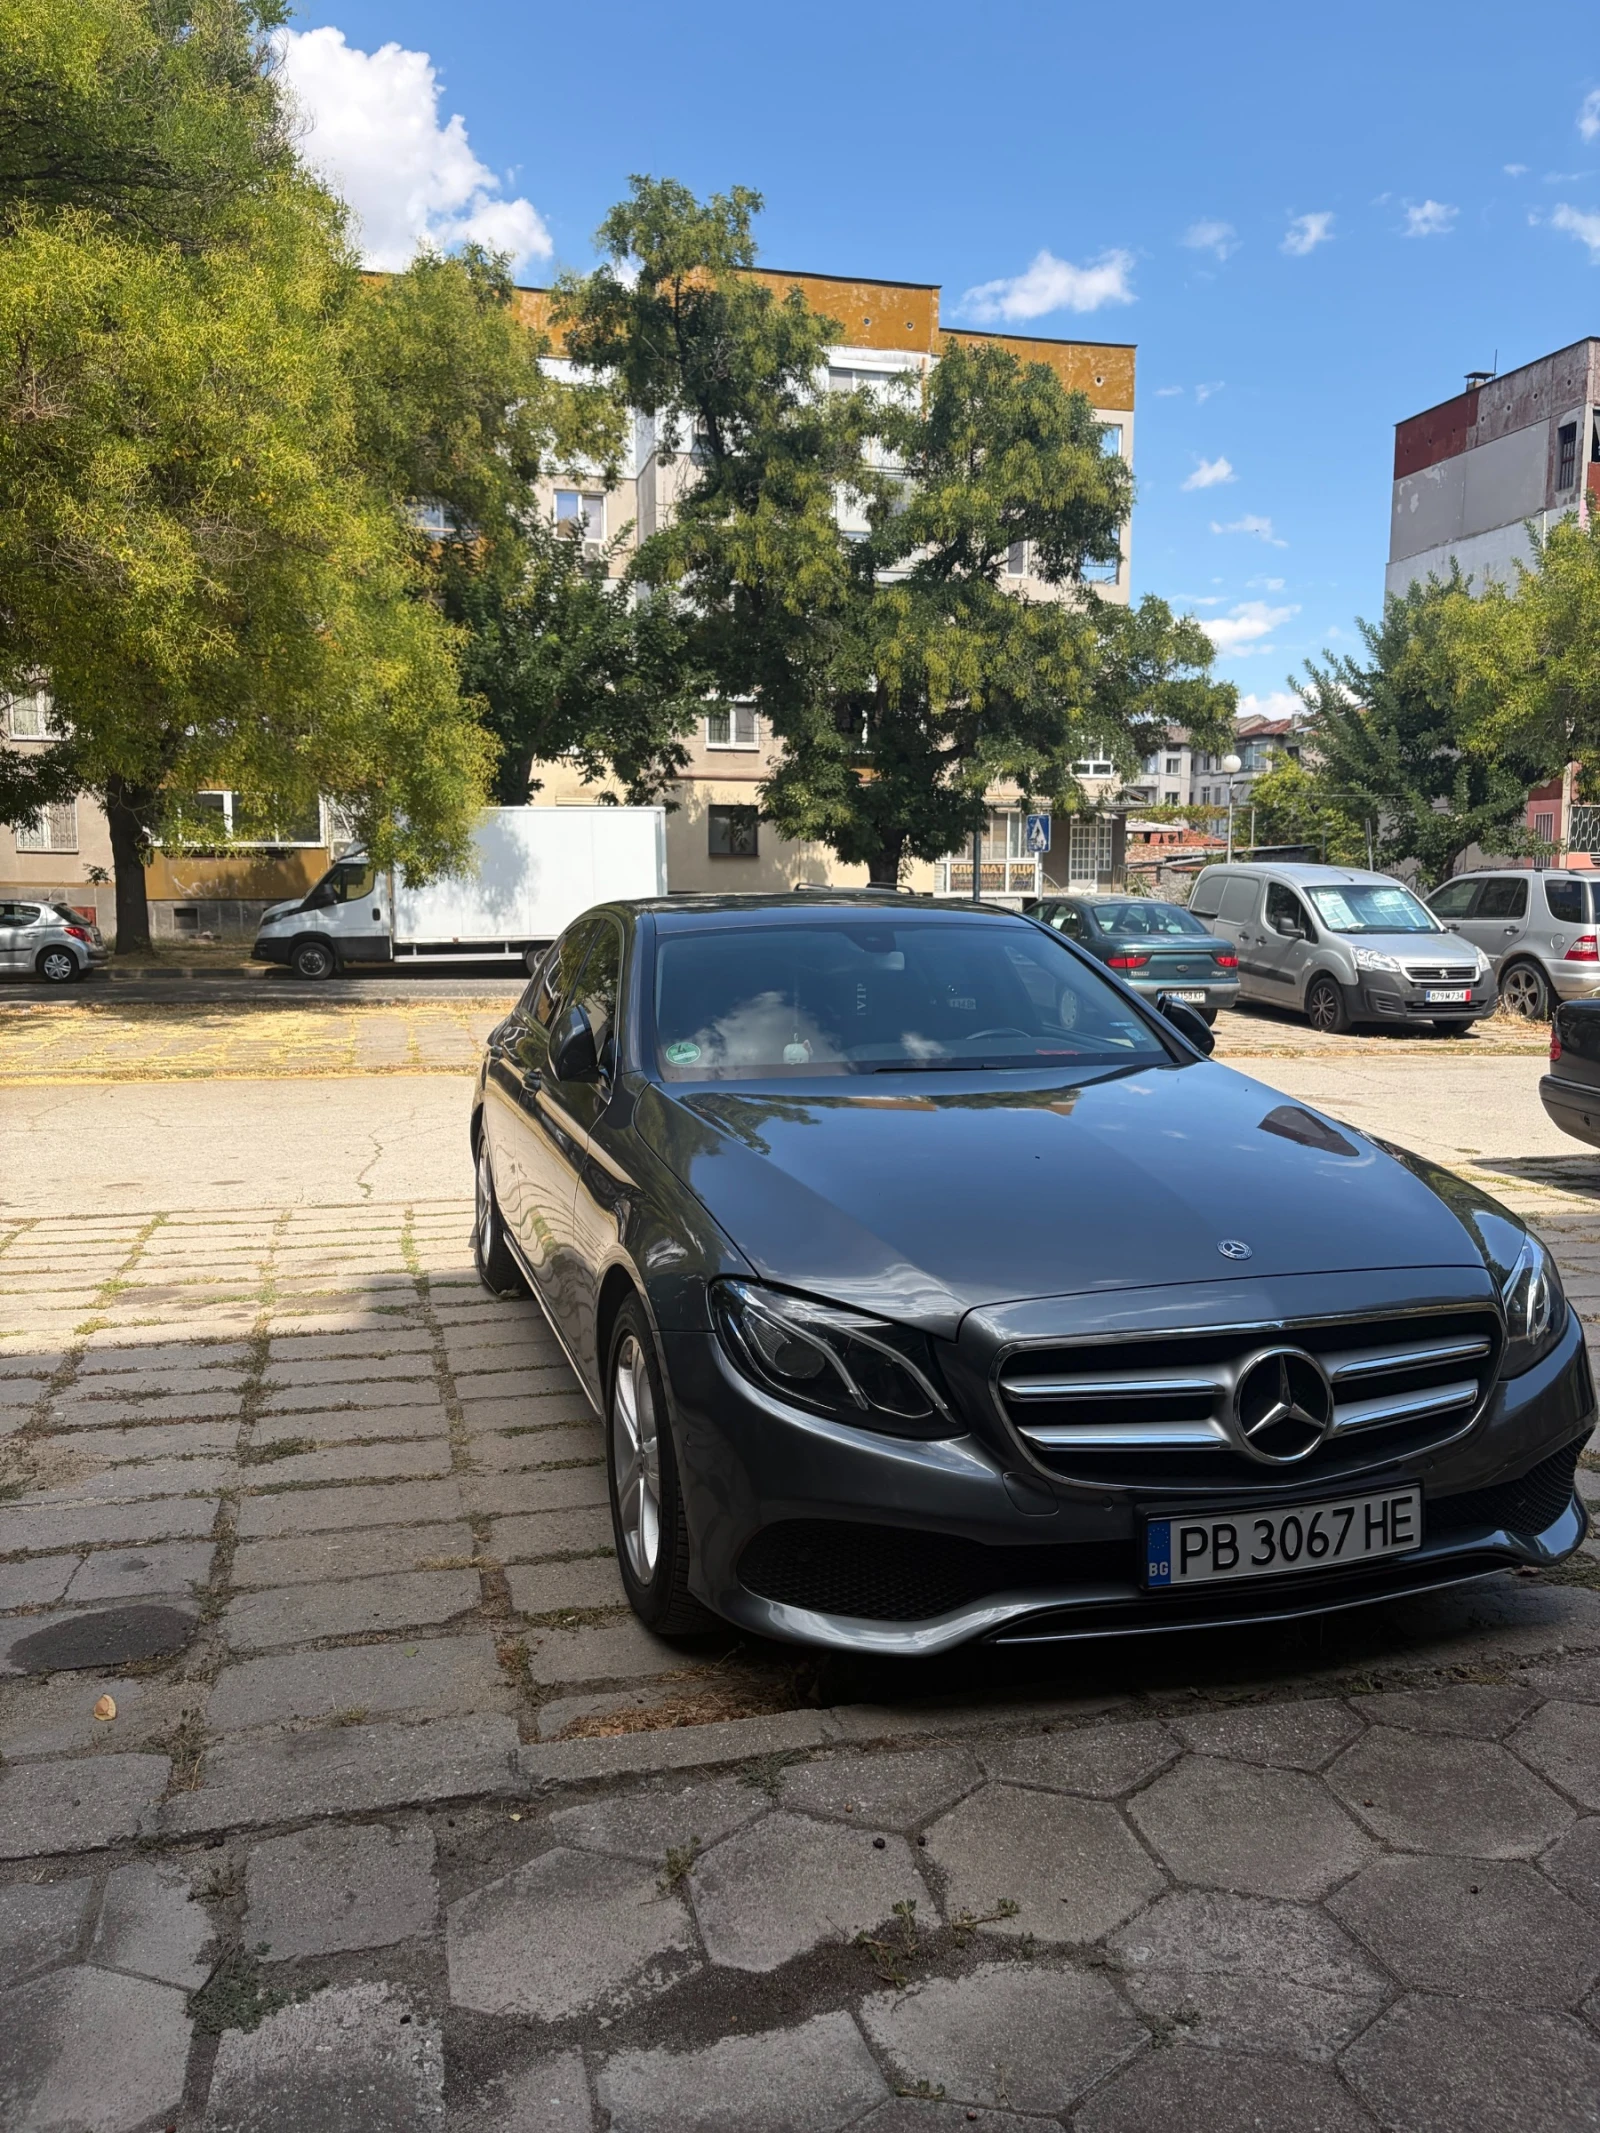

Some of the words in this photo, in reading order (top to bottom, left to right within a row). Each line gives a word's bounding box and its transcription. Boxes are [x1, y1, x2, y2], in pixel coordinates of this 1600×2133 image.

[1179, 1523, 1240, 1575] PB
[1250, 1506, 1356, 1566] 3067
[1364, 1495, 1415, 1550] HE
[1148, 1562, 1169, 1577] BG
